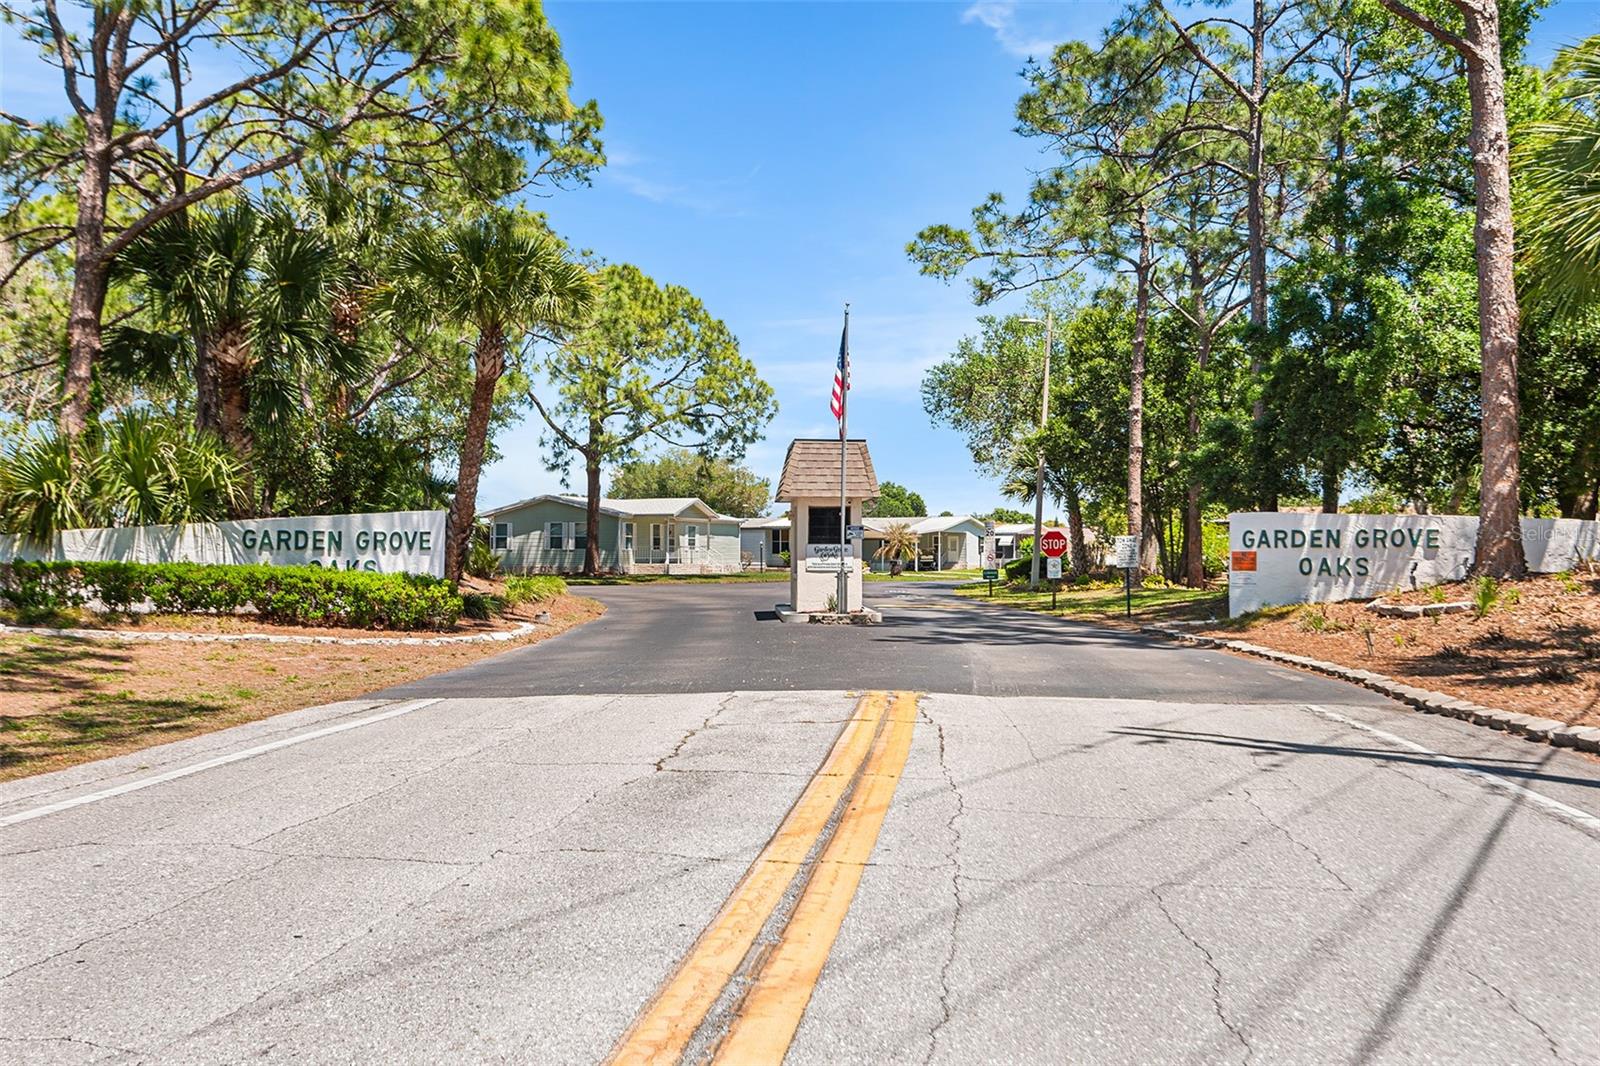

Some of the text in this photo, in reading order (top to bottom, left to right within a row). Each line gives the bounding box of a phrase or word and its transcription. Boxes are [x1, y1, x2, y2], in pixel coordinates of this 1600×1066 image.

[242, 529, 432, 552] GARDEN GROVE
[1042, 538, 1066, 550] STOP
[1242, 528, 1440, 549] GARDEN GROVE
[1298, 557, 1370, 577] OAKS
